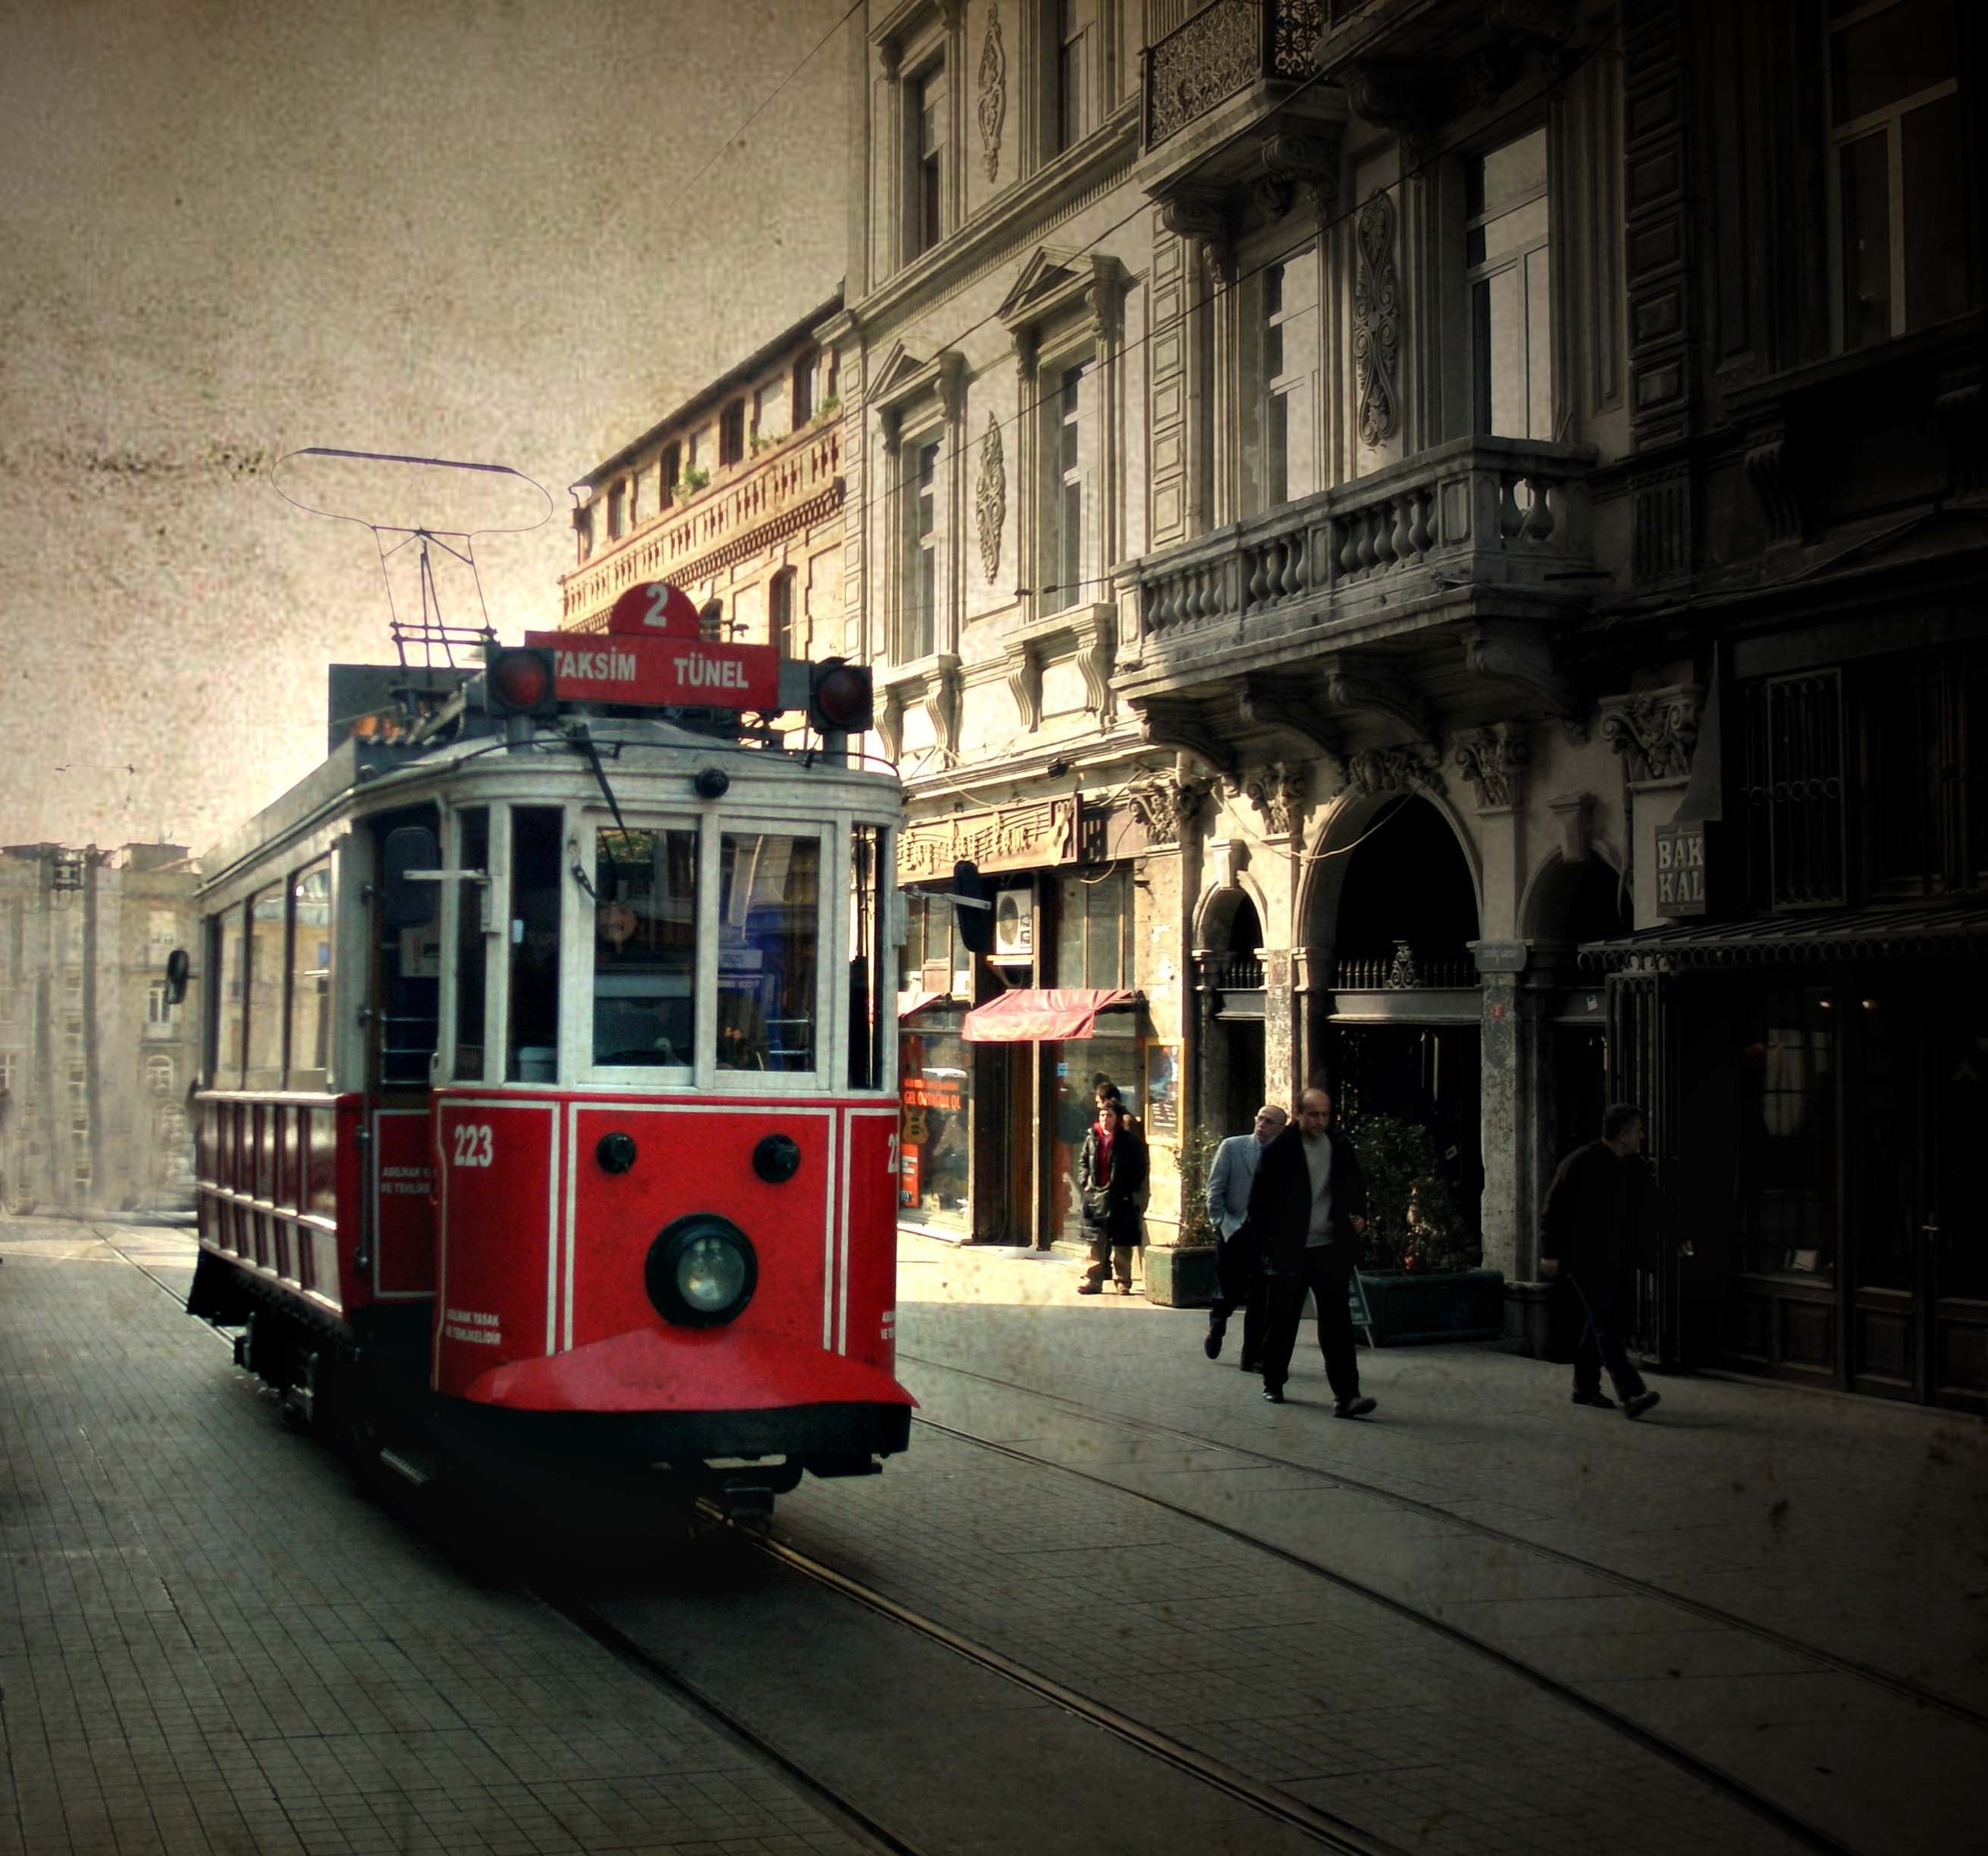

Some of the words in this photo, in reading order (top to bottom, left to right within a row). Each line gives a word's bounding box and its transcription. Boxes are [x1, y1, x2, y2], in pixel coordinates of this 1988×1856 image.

[642, 583, 669, 628] 2
[673, 652, 749, 688] TÜNEL
[1657, 836, 1704, 869] BAK
[1658, 871, 1704, 903] KAL
[453, 1124, 494, 1168] 223
